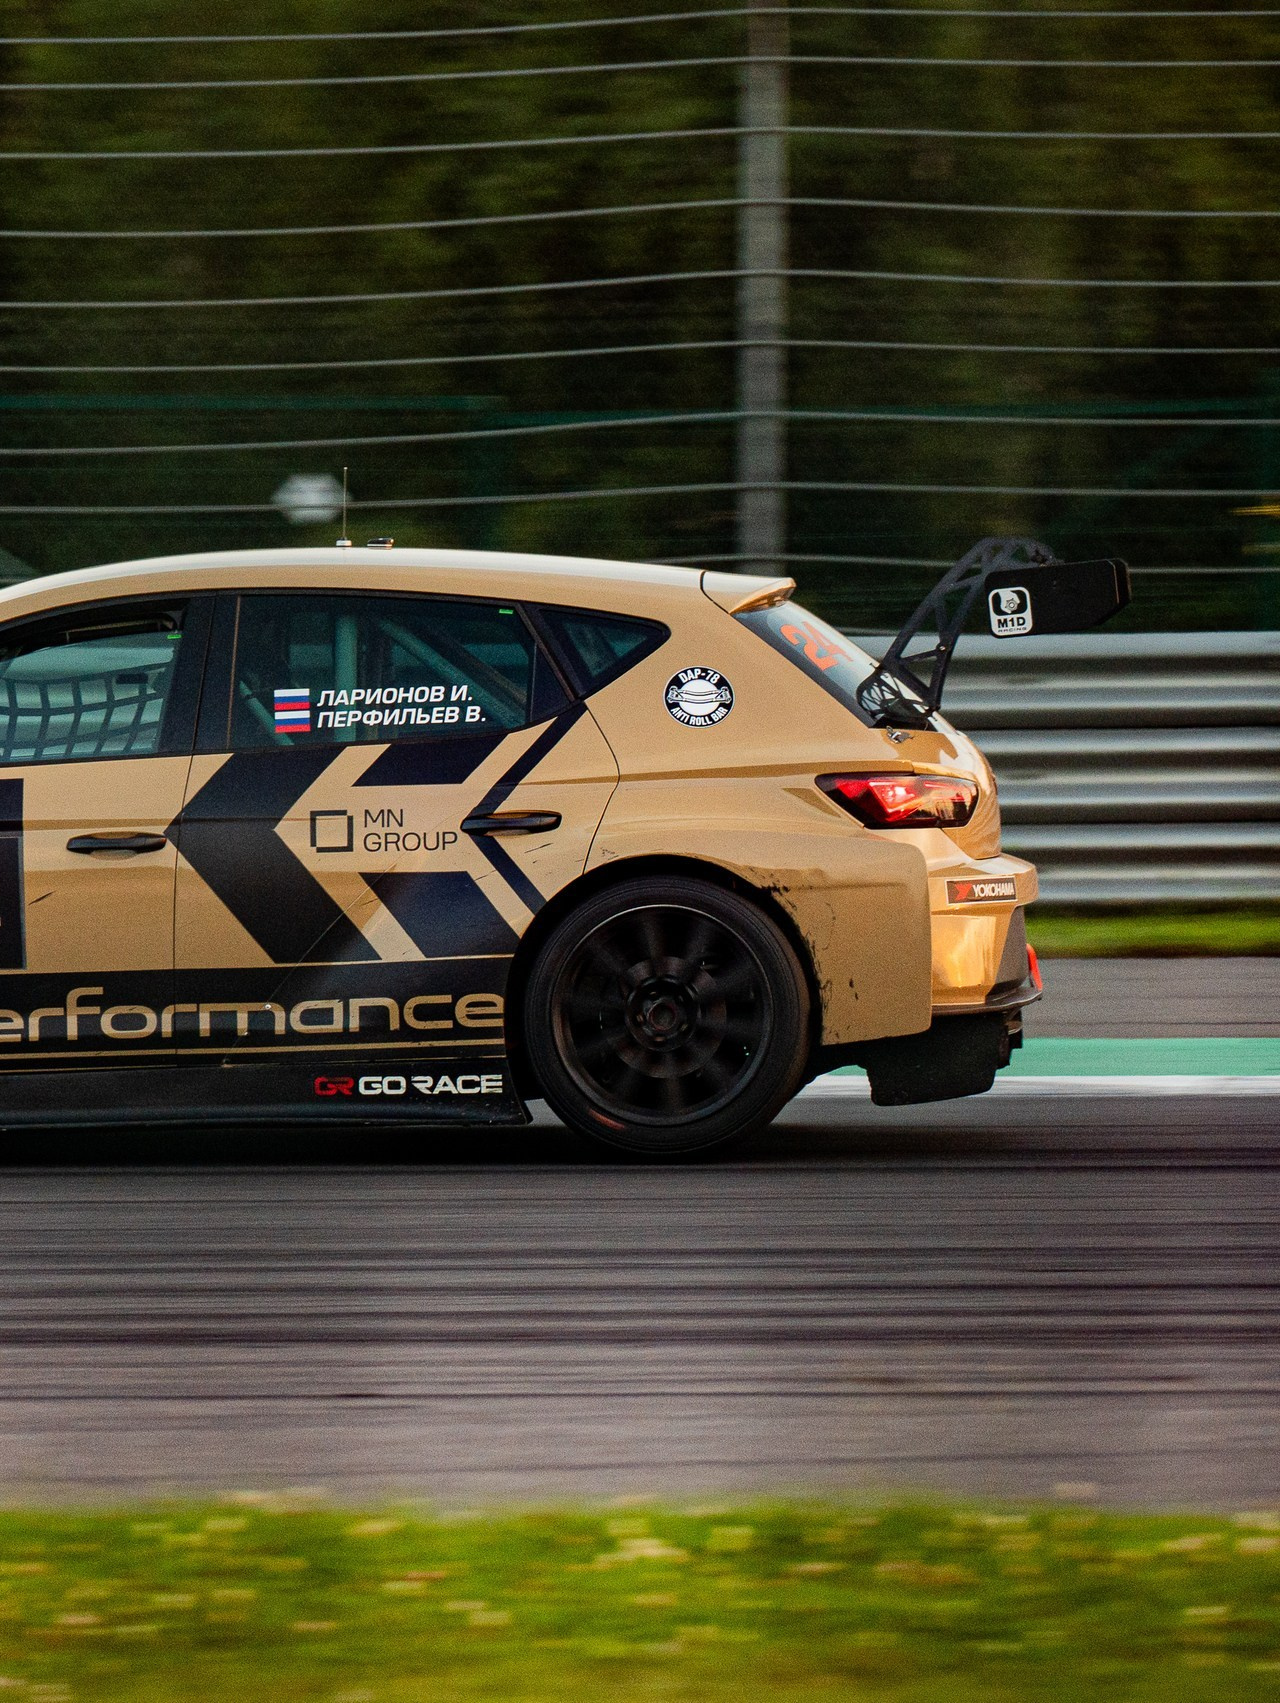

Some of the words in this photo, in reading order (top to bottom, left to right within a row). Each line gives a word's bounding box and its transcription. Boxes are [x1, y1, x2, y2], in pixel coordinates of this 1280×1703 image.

[997, 617, 1026, 628] M1D
[678, 669, 720, 684] DAP-78
[317, 686, 445, 707] ЛАРИОНОВ
[450, 685, 473, 702] И.
[317, 707, 460, 728] ПЕРФИЛЬЕВ
[464, 706, 486, 723] В.
[670, 707, 690, 723] ANTI
[689, 716, 712, 725] ROLL
[711, 707, 728, 722] BAR
[363, 808, 404, 828] MN
[363, 831, 458, 852] GROUP
[972, 883, 1015, 897] YOKOHAMA
[358, 1076, 407, 1095] GO
[411, 1074, 503, 1094] RACE
